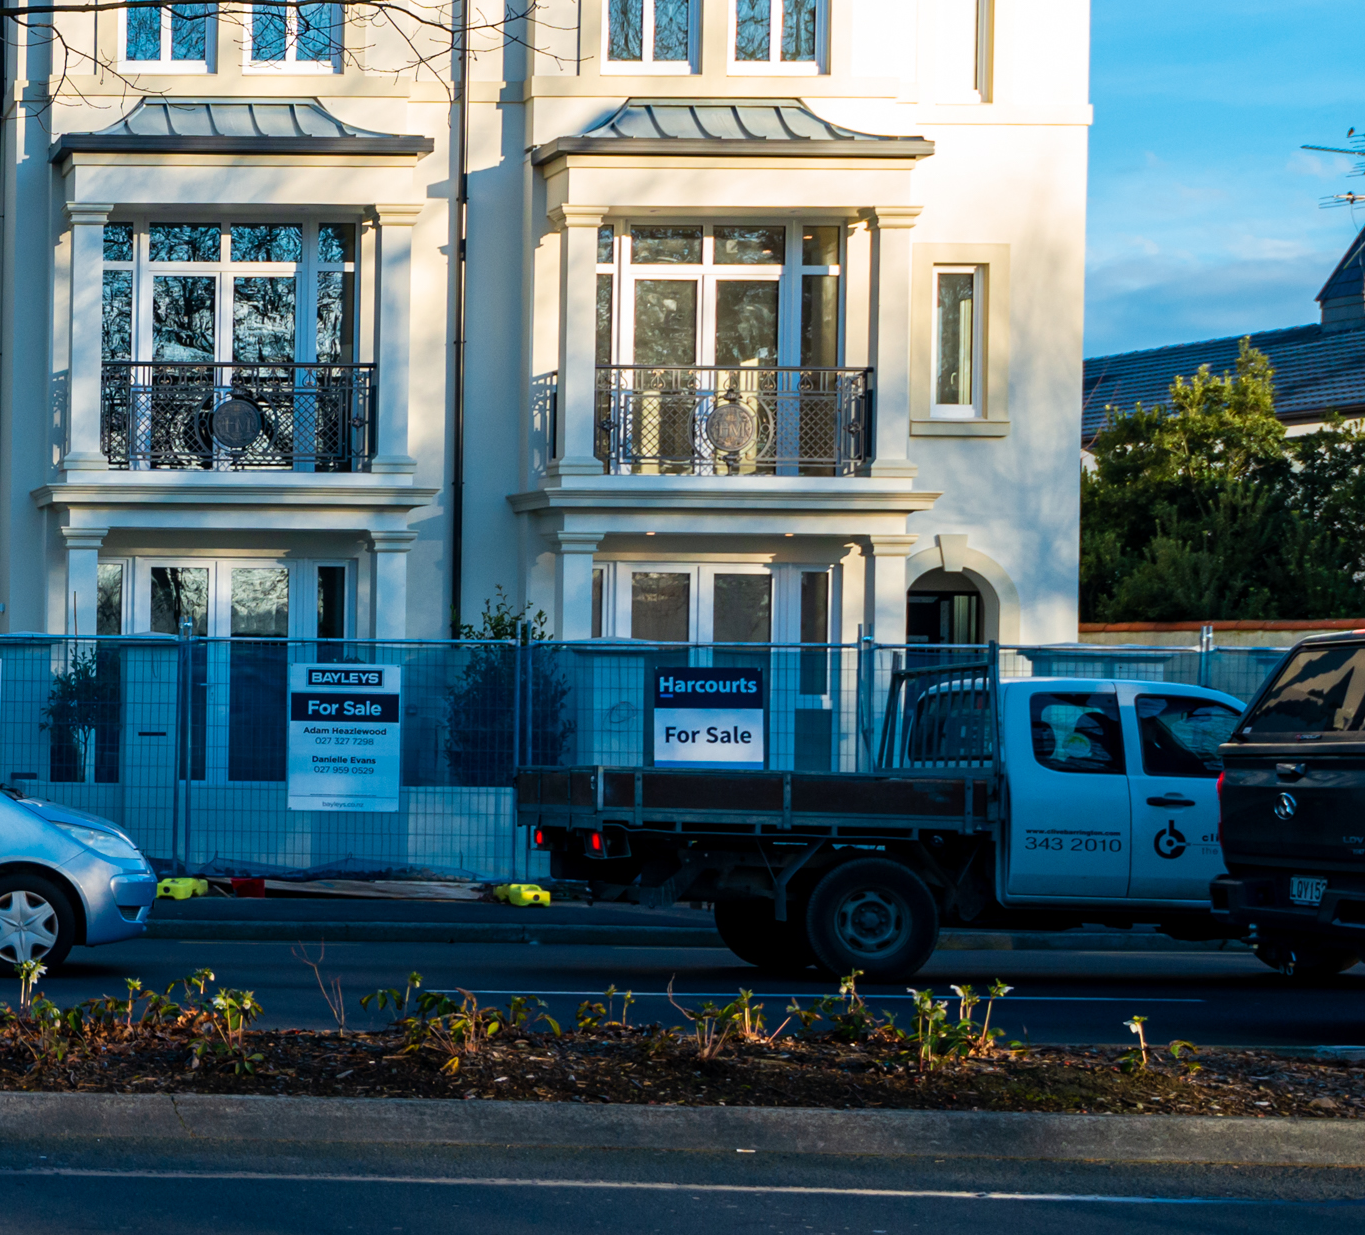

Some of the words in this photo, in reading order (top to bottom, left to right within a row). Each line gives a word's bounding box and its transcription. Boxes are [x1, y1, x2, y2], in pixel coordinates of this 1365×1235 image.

[311, 672, 379, 684] BAYLEYS
[659, 676, 758, 693] Harcourts
[307, 700, 339, 715] For
[343, 700, 382, 716] Sale
[332, 727, 386, 735] Heazlewood
[665, 726, 700, 743] For
[706, 726, 752, 744] Sale
[334, 737, 350, 745] 327
[312, 755, 348, 763] Danielle
[350, 756, 376, 764] Evans
[332, 766, 349, 774] 959
[1025, 837, 1063, 851] 343
[1070, 838, 1122, 852] 2010
[1342, 836, 1364, 844] LDV
